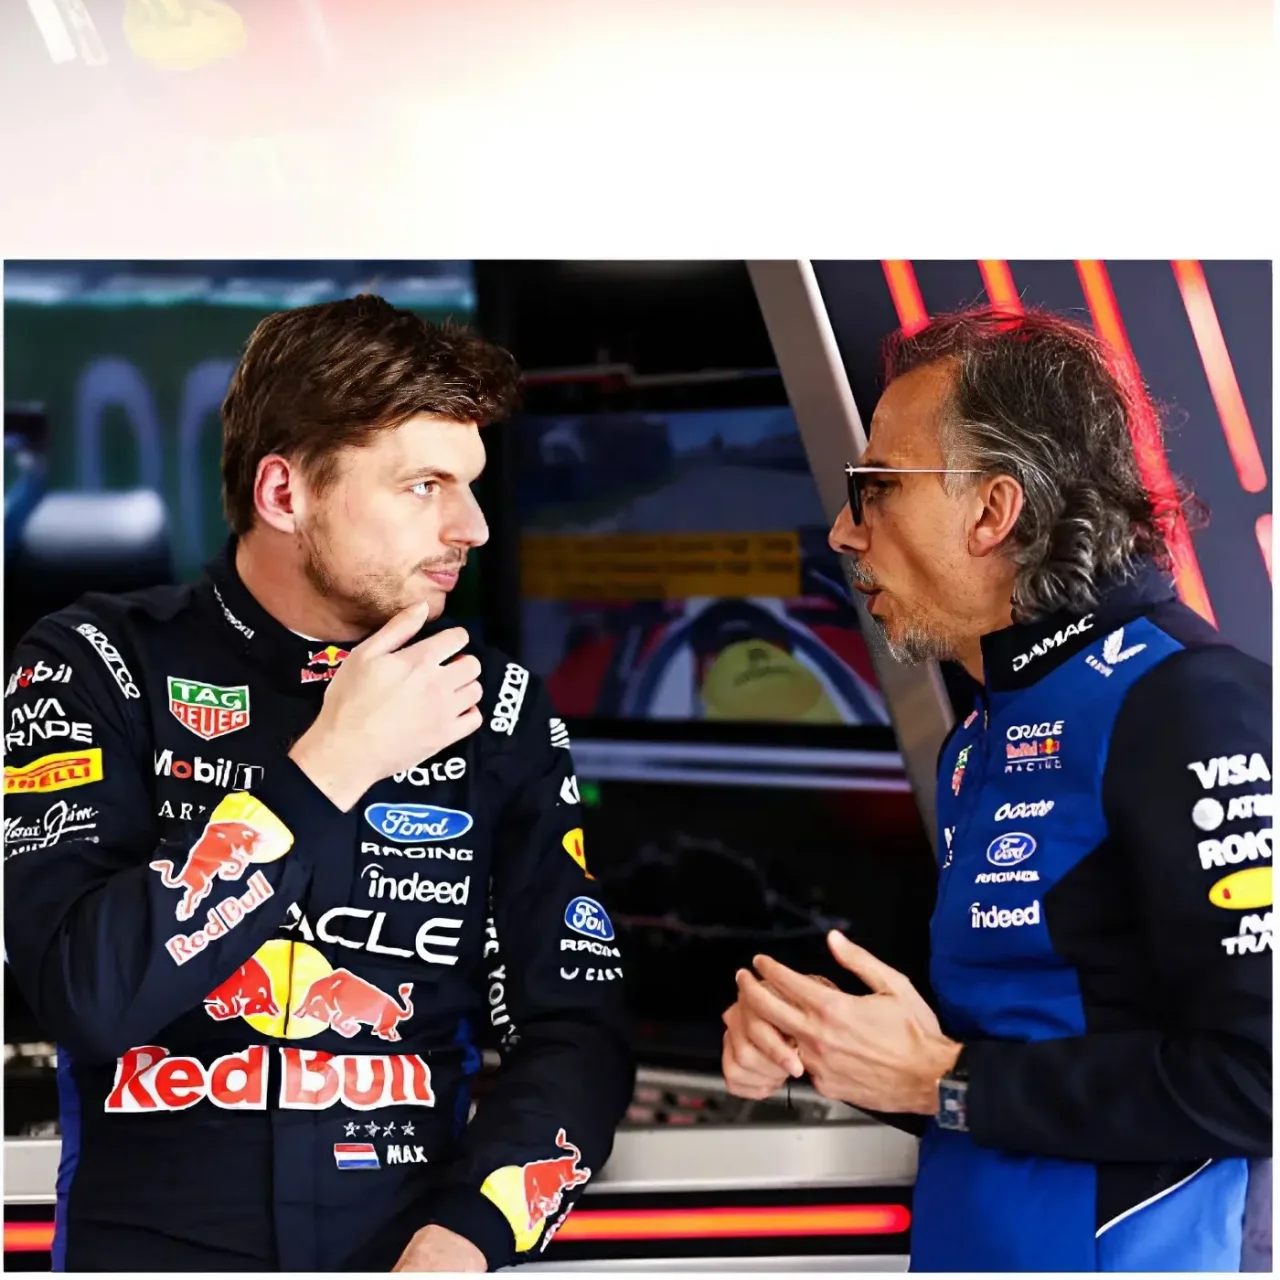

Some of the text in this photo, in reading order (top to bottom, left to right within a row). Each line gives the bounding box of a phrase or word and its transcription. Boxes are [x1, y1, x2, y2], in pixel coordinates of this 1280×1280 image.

[1012, 613, 1094, 671] DAMAC
[173, 682, 242, 710] TAG
[4, 720, 93, 751] RADE
[1186, 753, 1271, 790] VISA
[381, 809, 449, 836] Ford
[1197, 827, 1273, 870] ROK
[362, 864, 470, 905] indeed
[969, 901, 1040, 928] indeed
[279, 902, 464, 966] ACLE
[108, 1046, 434, 1112] Red Bull
[386, 1145, 428, 1164] MAX
